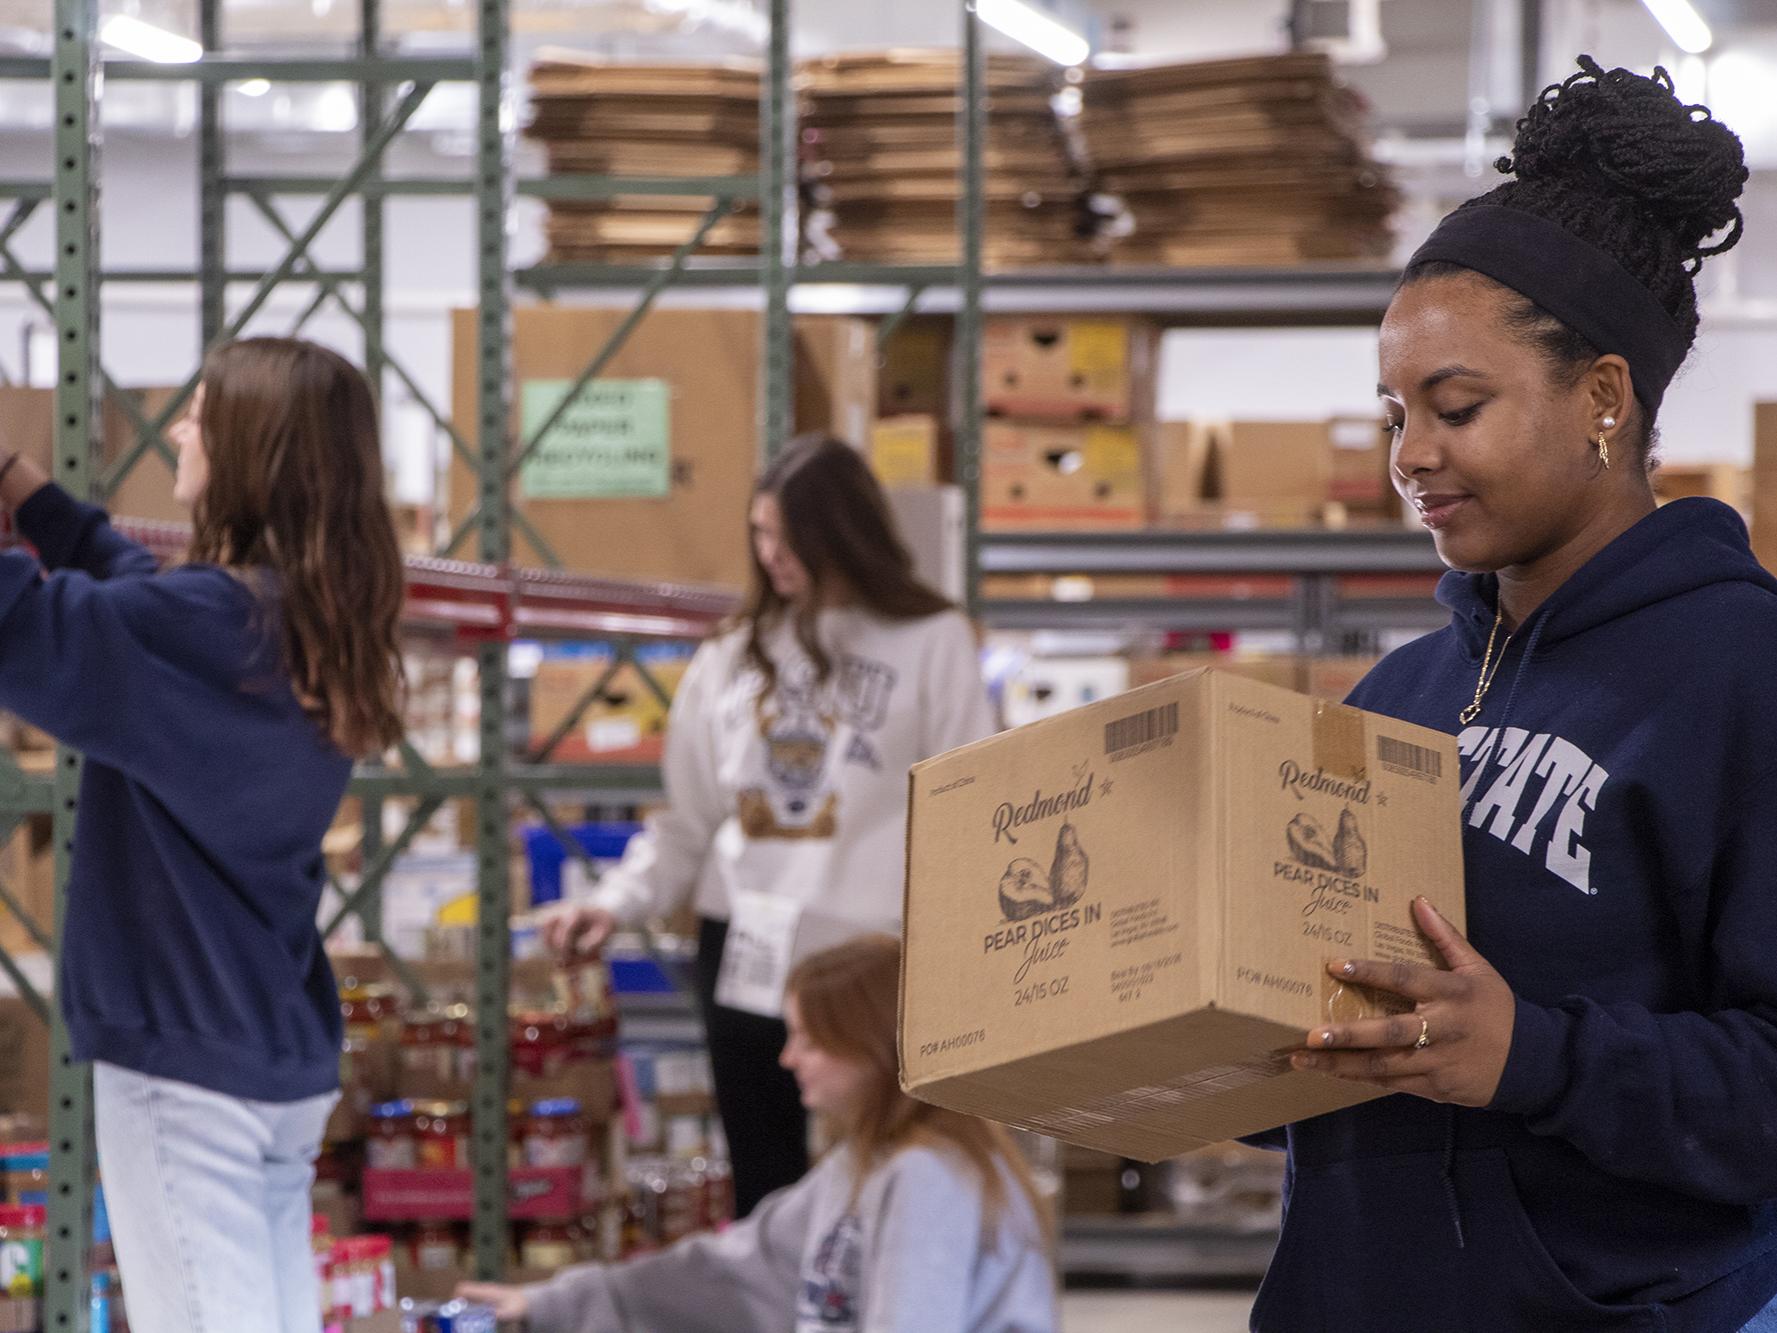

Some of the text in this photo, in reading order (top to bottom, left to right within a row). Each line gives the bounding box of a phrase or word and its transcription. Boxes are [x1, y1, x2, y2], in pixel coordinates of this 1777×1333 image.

[1279, 759, 1372, 805] Redmond
[993, 771, 1095, 845] Redmond
[1274, 861, 1380, 904] PEAR DICES IN
[1302, 885, 1353, 917] Juice
[983, 925, 1028, 954] PEAR
[1031, 907, 1081, 942] DICES
[1084, 901, 1102, 924] IN
[1334, 929, 1353, 947] OZ
[1013, 937, 1071, 985] Juice
[1013, 975, 1070, 1008] 24/15 OZ
[919, 1041, 939, 1058] PO#
